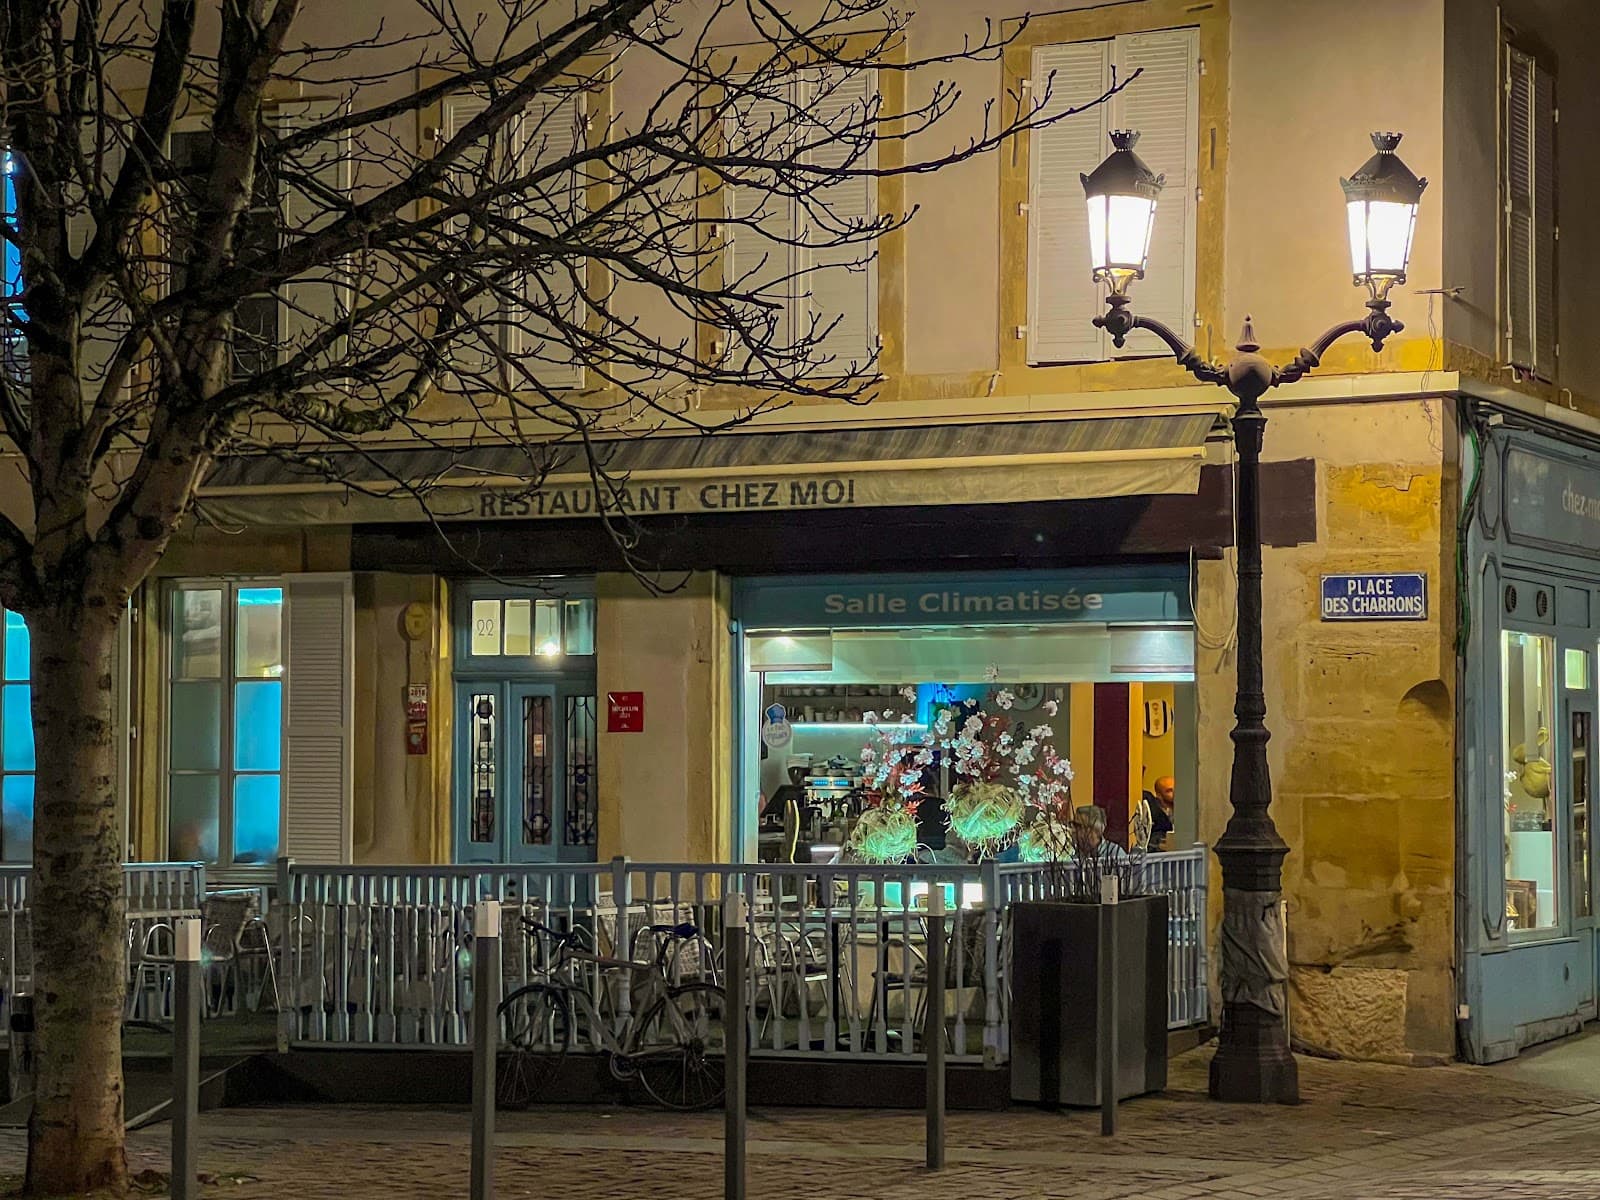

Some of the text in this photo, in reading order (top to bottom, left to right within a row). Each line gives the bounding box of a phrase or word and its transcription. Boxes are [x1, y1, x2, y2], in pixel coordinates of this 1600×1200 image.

[480, 478, 856, 517] RESTAURANT CHEZ MOI
[1347, 578, 1394, 596] PLACE
[824, 587, 1104, 614] Salle Climatisée
[1324, 595, 1422, 613] DES CHARRONS
[476, 618, 494, 637] 22
